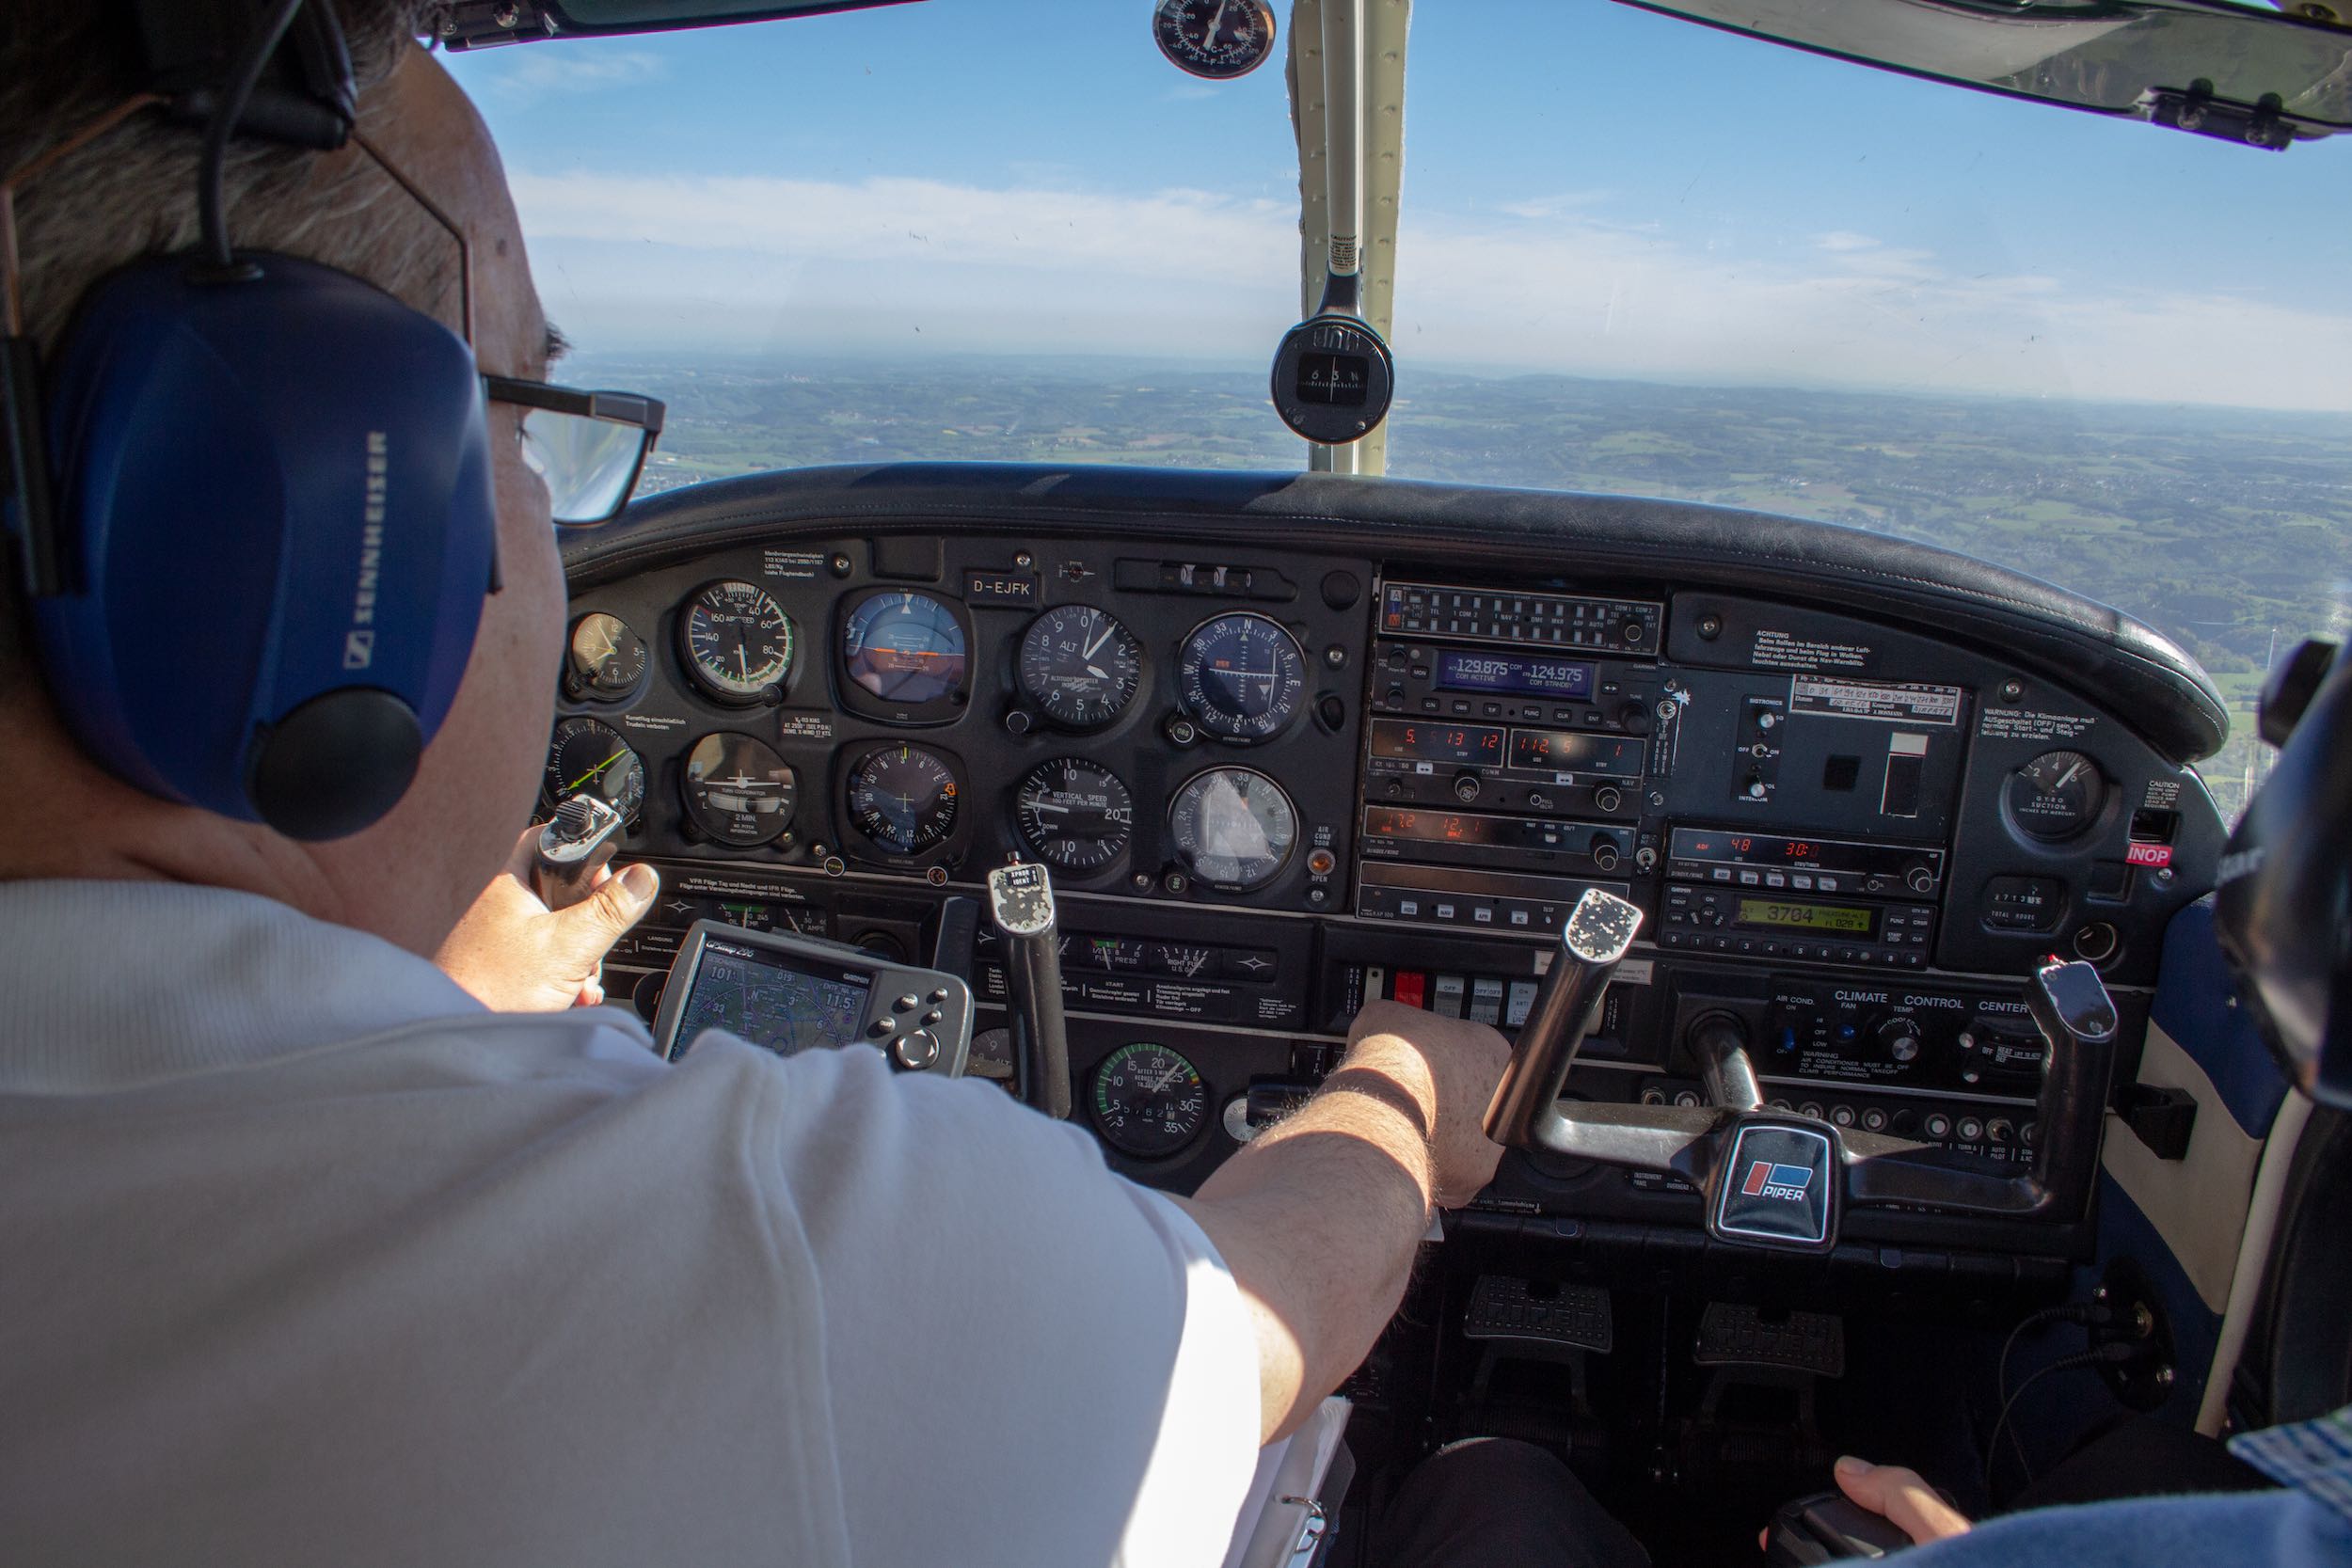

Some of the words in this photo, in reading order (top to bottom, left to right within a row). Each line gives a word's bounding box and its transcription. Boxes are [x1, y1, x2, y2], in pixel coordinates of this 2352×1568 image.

[354, 432, 387, 625] SENNHEISER
[975, 580, 1030, 594] D-EJFK
[711, 613, 724, 623] 160
[1080, 616, 1089, 627] 0
[760, 621, 772, 629] 60
[1055, 622, 1063, 633] 9
[1214, 623, 1227, 634] 33
[1244, 619, 1252, 630] N
[705, 633, 719, 641] 140
[1756, 630, 1789, 639] ACHTUNG
[1042, 635, 1049, 646] 8
[1194, 638, 1205, 651] 30
[1806, 641, 1829, 650] Bereich
[763, 645, 774, 655] 80
[1059, 641, 1077, 652] ALT
[1118, 644, 1126, 656] 2
[1754, 643, 1785, 653] fahrzeuge
[1816, 649, 1830, 657] Flug
[1457, 658, 1508, 675] 129.875
[1531, 665, 1582, 681] 124.975
[1041, 673, 1048, 685] 7
[1116, 677, 1124, 689] 3
[1052, 689, 1060, 701] 6
[1101, 694, 1109, 705] 4
[1076, 699, 1084, 710] 5
[1984, 708, 2022, 717] WARNUNG:
[2038, 712, 2079, 722] Klimaanlage
[1983, 716, 2032, 726] AUSgeschaltet
[2033, 720, 2056, 730] (OFF)
[2013, 723, 2032, 732] Start
[2057, 727, 2074, 737] Steig
[2022, 732, 2051, 740] erzielen.
[1482, 735, 1499, 749] 12
[2052, 762, 2059, 771] 4
[1064, 768, 1077, 781] 10
[1237, 772, 1249, 782] 33
[2033, 768, 2041, 777] 2
[2070, 773, 2077, 782] 6
[2149, 780, 2180, 789] CAUTION
[1053, 792, 1083, 800] VERTICAL
[1088, 794, 1107, 802] SPEED
[2031, 801, 2067, 810] SUCTION
[1104, 809, 1120, 820] 20
[1062, 840, 1075, 852] 10
[1731, 838, 1751, 851] 48
[2127, 847, 2169, 863] INOP
[1992, 910, 2009, 918] TOTAL
[1789, 996, 1815, 1006] COND.
[1835, 990, 1888, 1003] CLIMATE
[1904, 995, 1964, 1009] CONTROL
[1979, 1001, 2028, 1013] CENTER
[990, 1040, 998, 1052] 9
[1982, 1046, 1993, 1054] OFF
[1997, 1046, 2012, 1054] HEAT
[1803, 1051, 1838, 1059] WARNING
[1128, 1061, 1136, 1070] 15
[1152, 1057, 1165, 1069] 20
[1816, 1058, 1859, 1067] CONDITIONER
[1823, 1069, 1870, 1078] PERFORMANCE
[1113, 1076, 1123, 1086] 10
[1113, 1100, 1120, 1110] 5
[1179, 1101, 1194, 1111] 30
[1116, 1117, 1124, 1127] 3
[1164, 1122, 1178, 1132] 35
[1762, 1185, 1804, 1201] PIPER
